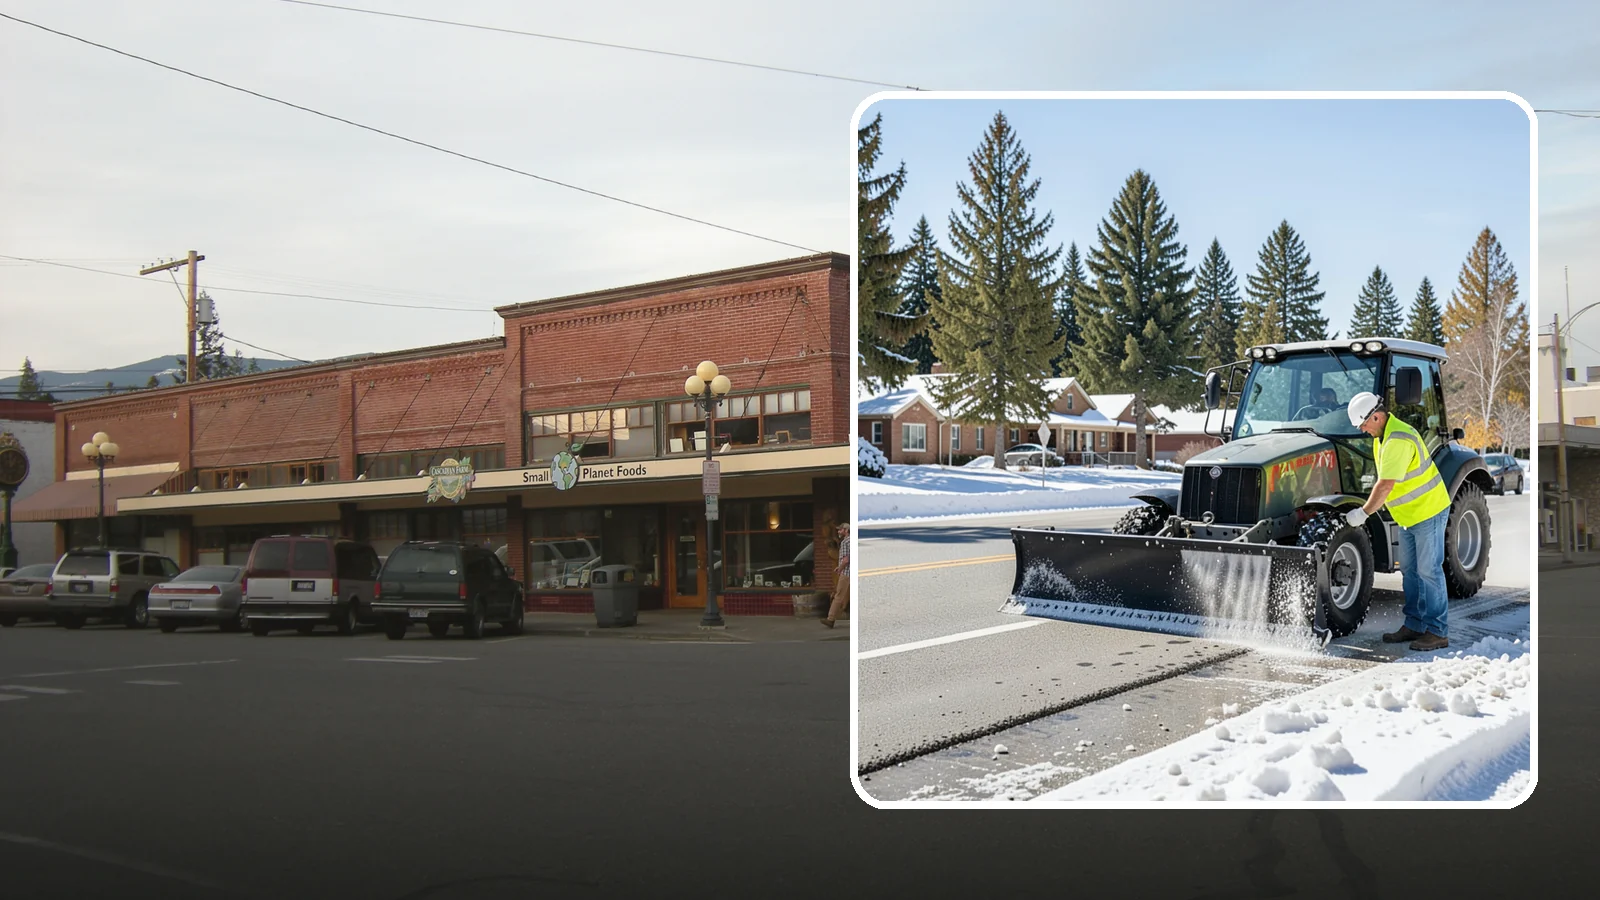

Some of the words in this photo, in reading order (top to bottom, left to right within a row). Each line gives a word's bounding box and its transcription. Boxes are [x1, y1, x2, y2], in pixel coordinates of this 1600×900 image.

[523, 471, 549, 483] Small
[583, 468, 614, 479] Planet
[617, 464, 647, 477] Foods
